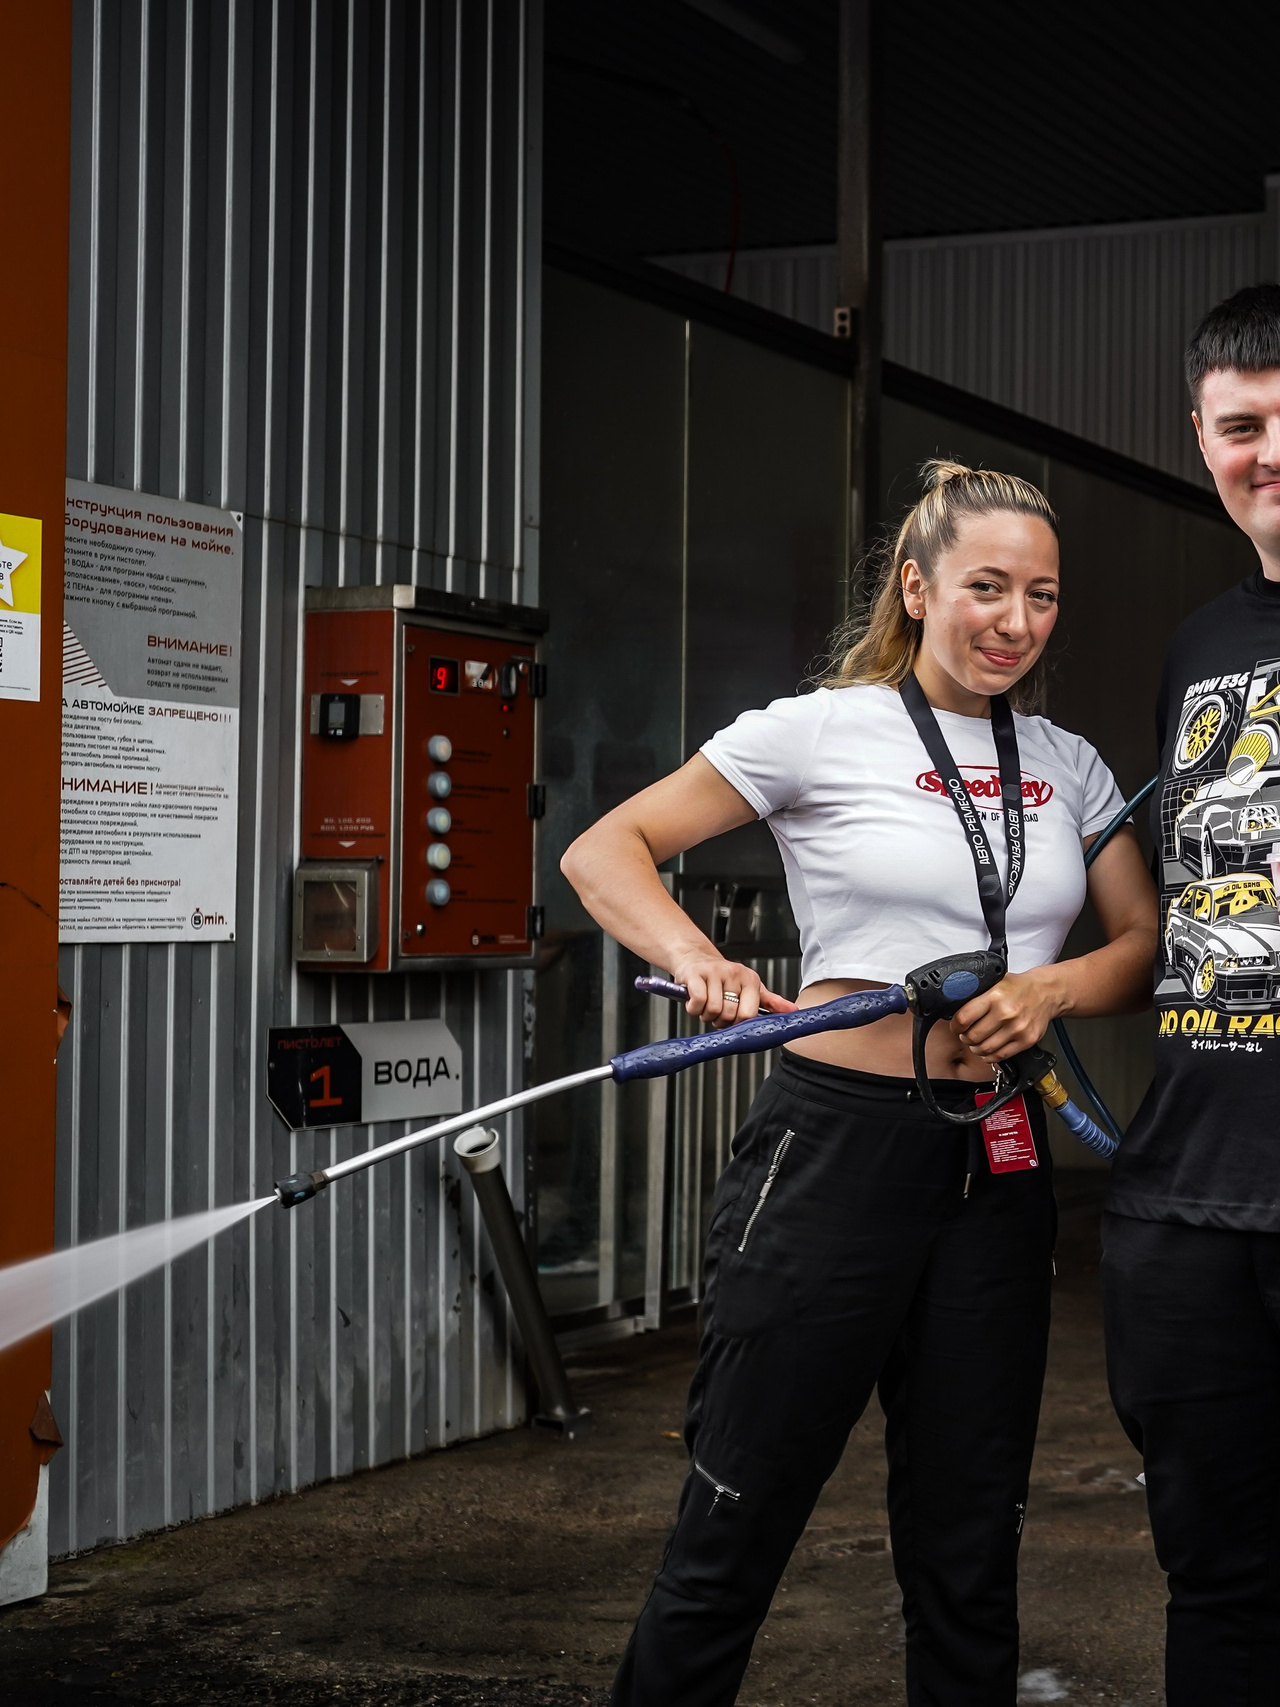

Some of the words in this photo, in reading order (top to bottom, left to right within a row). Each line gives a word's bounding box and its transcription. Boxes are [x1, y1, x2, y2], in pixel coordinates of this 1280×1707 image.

[66, 497, 142, 520] нструкция
[147, 512, 234, 538] пользования
[64, 513, 166, 543] борудованием
[171, 535, 187, 547] на
[191, 539, 234, 556] мойке.
[65, 536, 87, 546] несите
[89, 539, 133, 554] необходимую
[65, 547, 92, 558] озьмите
[99, 553, 115, 561] руки
[100, 564, 111, 572] для
[100, 587, 111, 595] для
[65, 594, 90, 603] ажмите
[92, 598, 114, 609] кнопку
[147, 634, 233, 658] ВНИМАНИЕ!
[147, 656, 172, 666] Автомат
[1183, 676, 1222, 701] BMW
[1218, 671, 1251, 690] E36
[61, 698, 68, 708] А
[71, 699, 145, 715] АВТОМОЙКЕ
[148, 706, 232, 723] ЗАПРЕЩЕНО!!!
[62, 776, 153, 796] НИМАНИЕ!
[59, 876, 102, 886] оставляйте
[103, 876, 125, 887] детей
[126, 877, 139, 886] без
[1243, 881, 1261, 889] GANG
[204, 912, 228, 925] min.
[1181, 1009, 1223, 1038] OIL
[277, 1036, 343, 1050] ПИСТОЛЕТ
[1191, 1038, 1263, 1053] オイルレーサーなし
[374, 1056, 460, 1089] ВОДА.
[309, 1065, 343, 1108] 1
